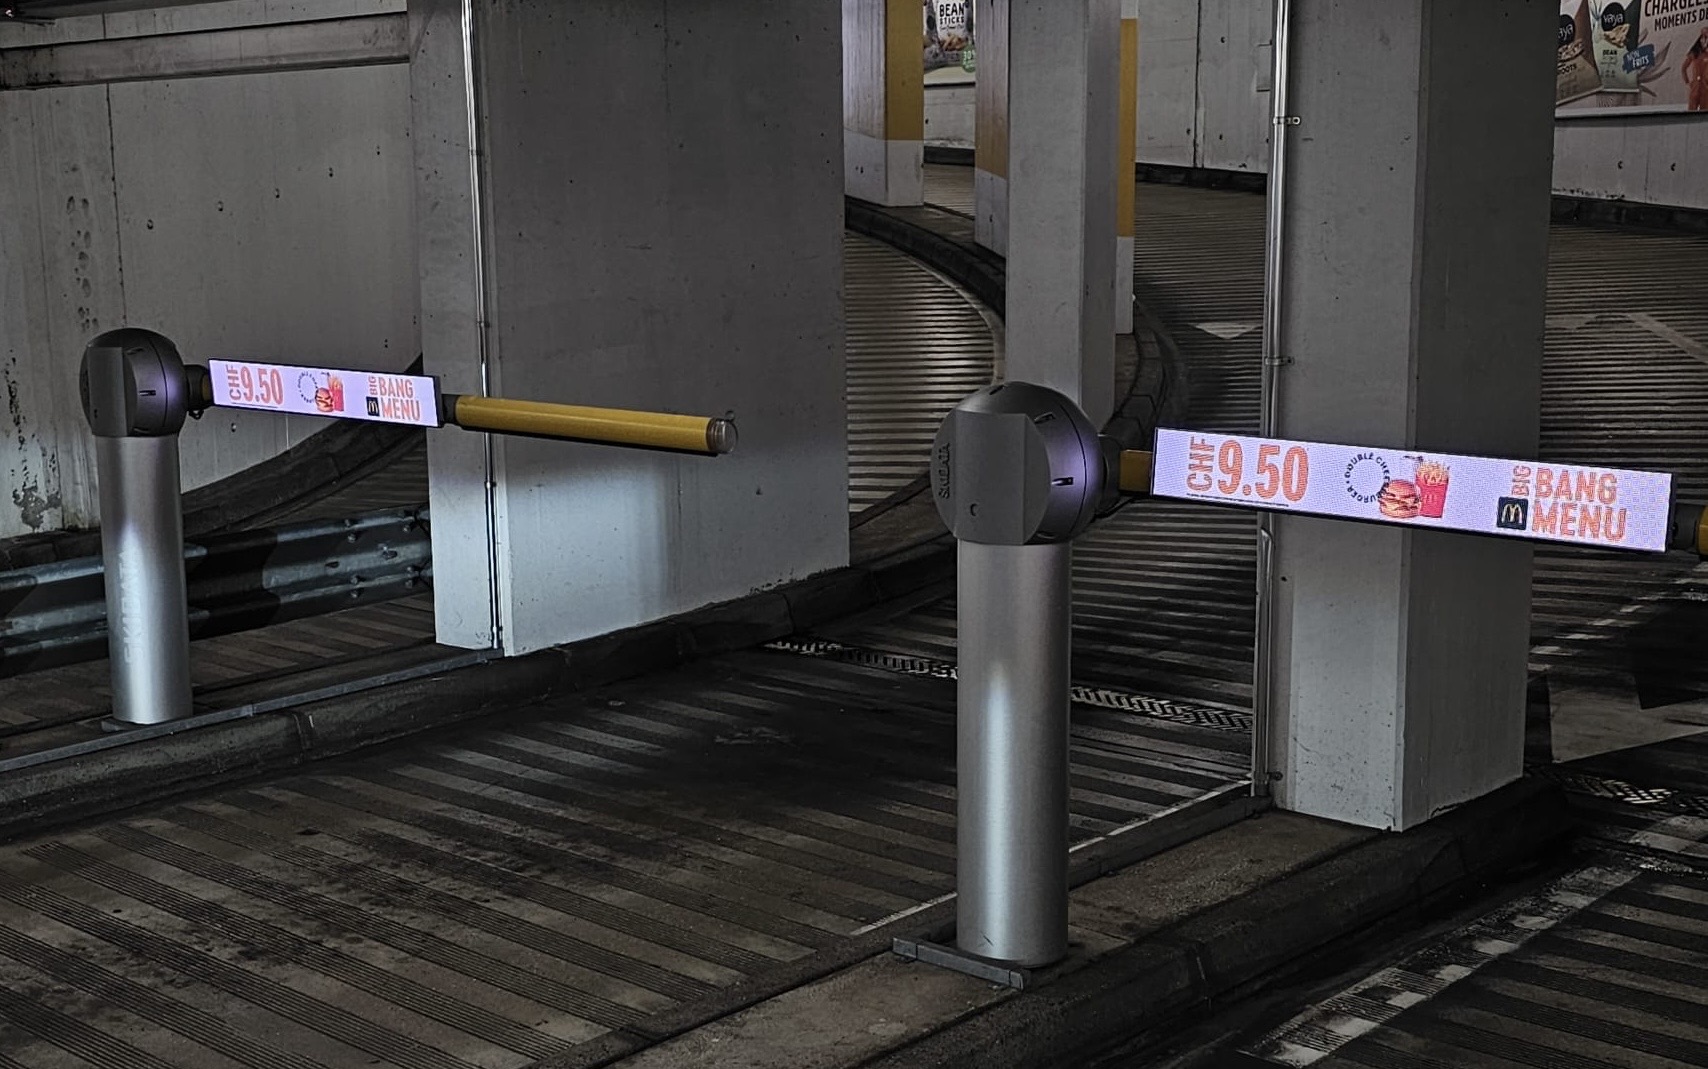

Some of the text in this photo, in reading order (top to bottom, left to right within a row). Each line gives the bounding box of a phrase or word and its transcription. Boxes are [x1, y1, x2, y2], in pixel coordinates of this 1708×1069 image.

[940, 3, 964, 17] BEAN
[940, 16, 964, 25] STICKS
[1654, 10, 1697, 32] MOMENTS
[225, 364, 241, 401] CHF
[240, 366, 284, 406] 9.50
[368, 376, 378, 396] BIG
[378, 377, 413, 398] BANG
[381, 398, 421, 422] MENU
[1186, 435, 1215, 492] CHF
[1217, 440, 1309, 502] 9.50
[1511, 465, 1531, 496] BIG
[1535, 467, 1618, 505] BANG
[1531, 499, 1627, 542] MENU
